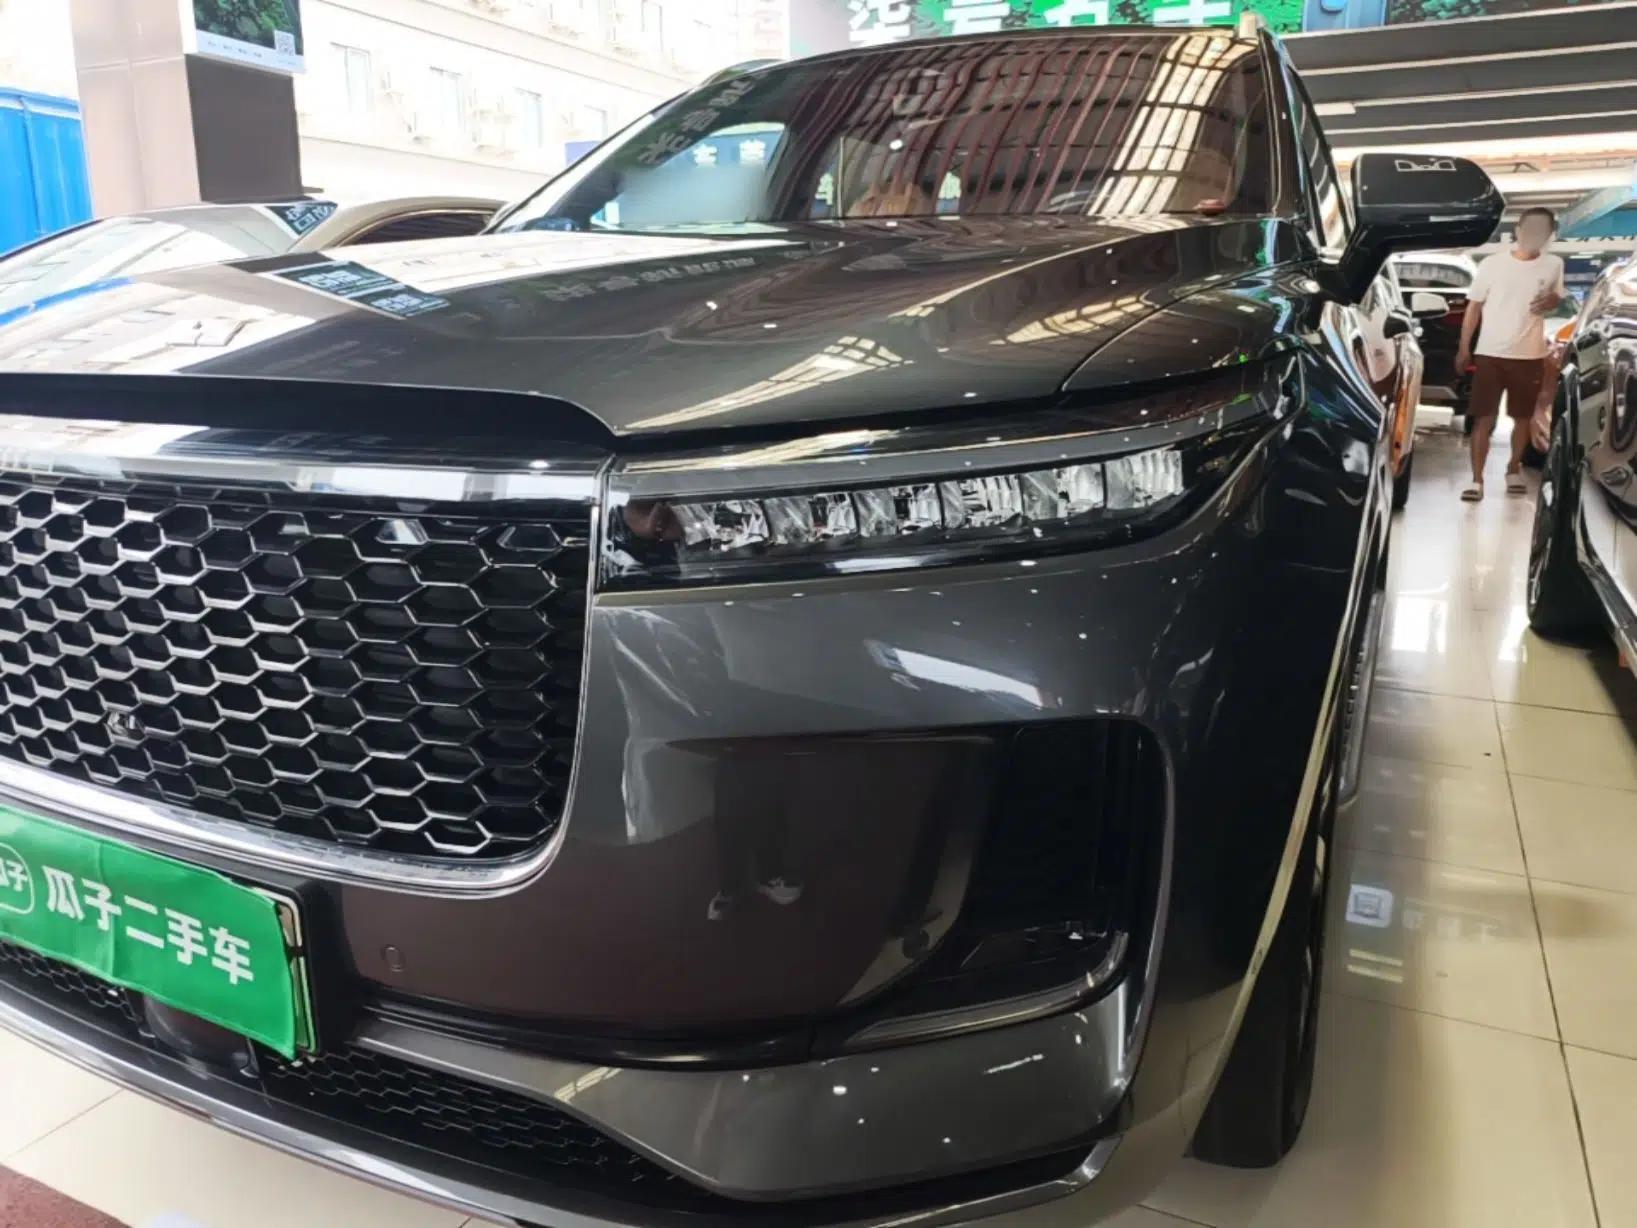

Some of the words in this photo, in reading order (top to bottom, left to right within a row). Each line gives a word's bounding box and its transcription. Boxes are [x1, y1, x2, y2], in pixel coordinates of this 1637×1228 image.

[42, 865, 254, 985] 瓜子二手车
